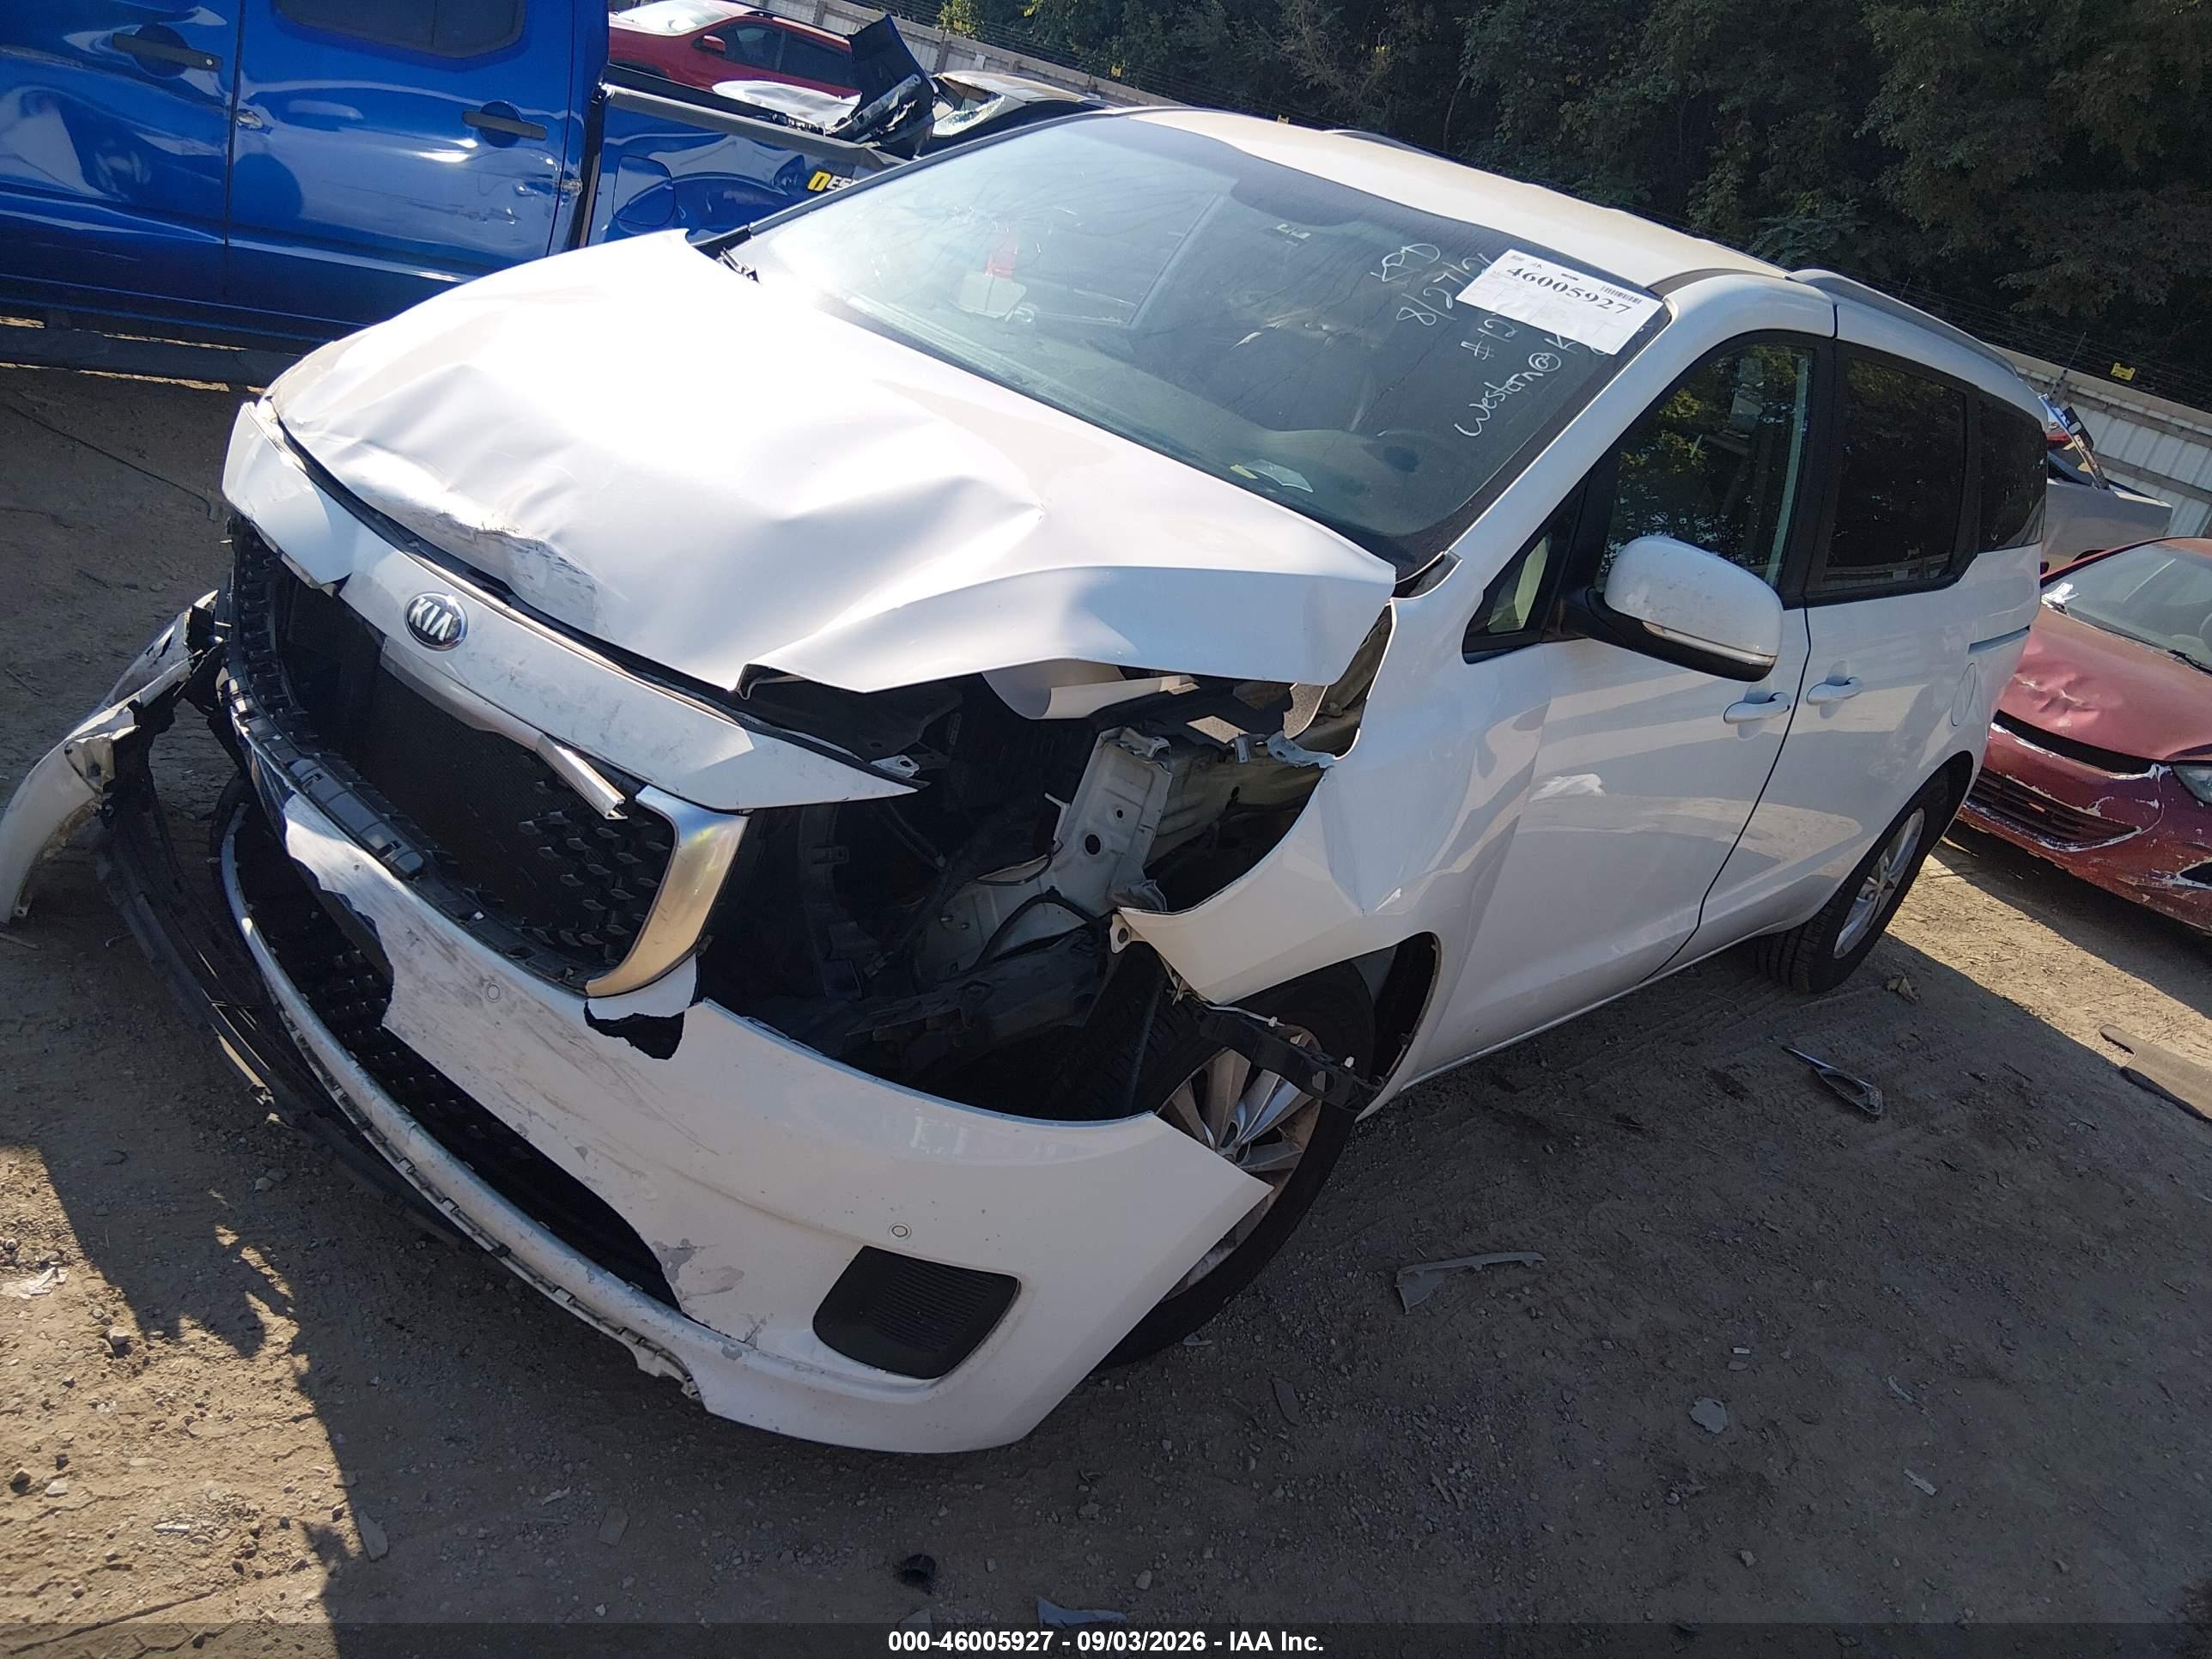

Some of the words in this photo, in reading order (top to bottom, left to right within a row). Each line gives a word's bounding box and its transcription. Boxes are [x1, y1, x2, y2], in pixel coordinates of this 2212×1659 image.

[808, 171, 859, 191] DES
[1506, 268, 1632, 314] 46005927
[410, 598, 453, 641] KIA
